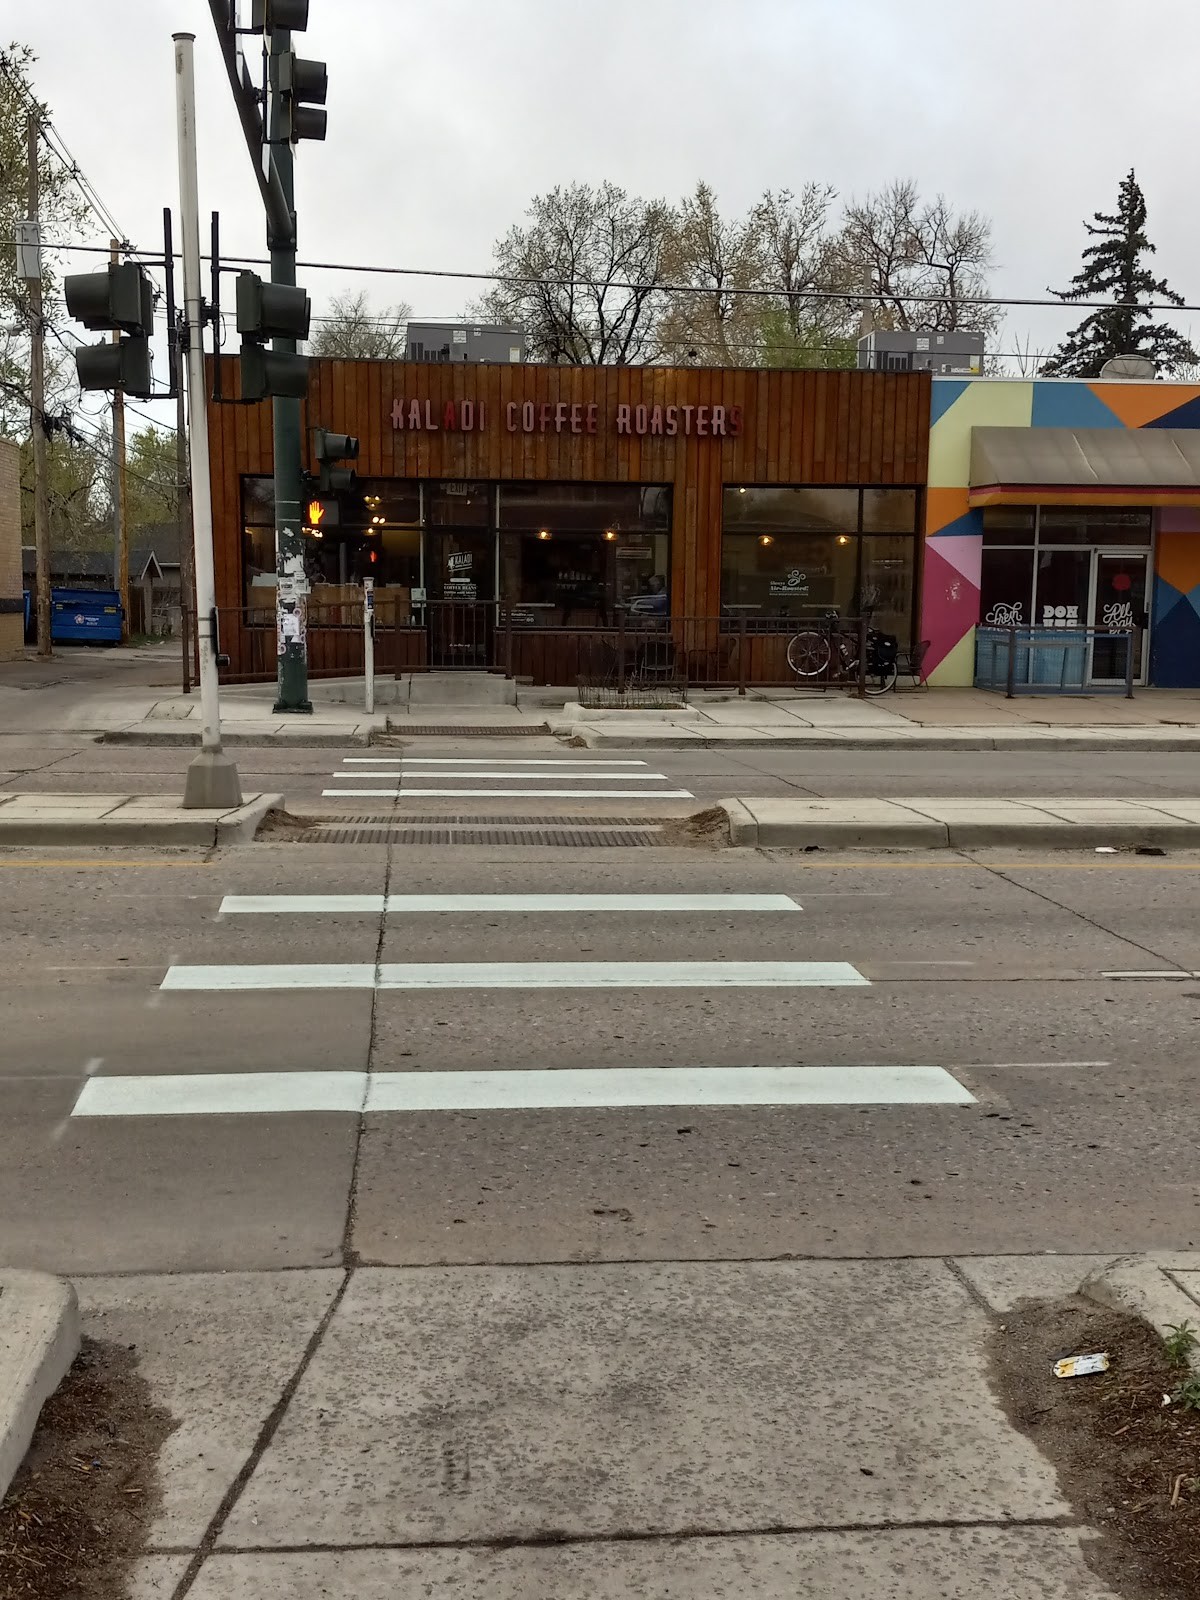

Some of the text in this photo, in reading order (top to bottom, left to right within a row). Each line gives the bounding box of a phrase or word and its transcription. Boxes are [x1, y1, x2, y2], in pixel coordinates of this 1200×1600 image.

[390, 399, 743, 436] KALADI COFFEE ROASTERS
[985, 602, 1023, 626] Fresh
[1103, 602, 1133, 623] All
